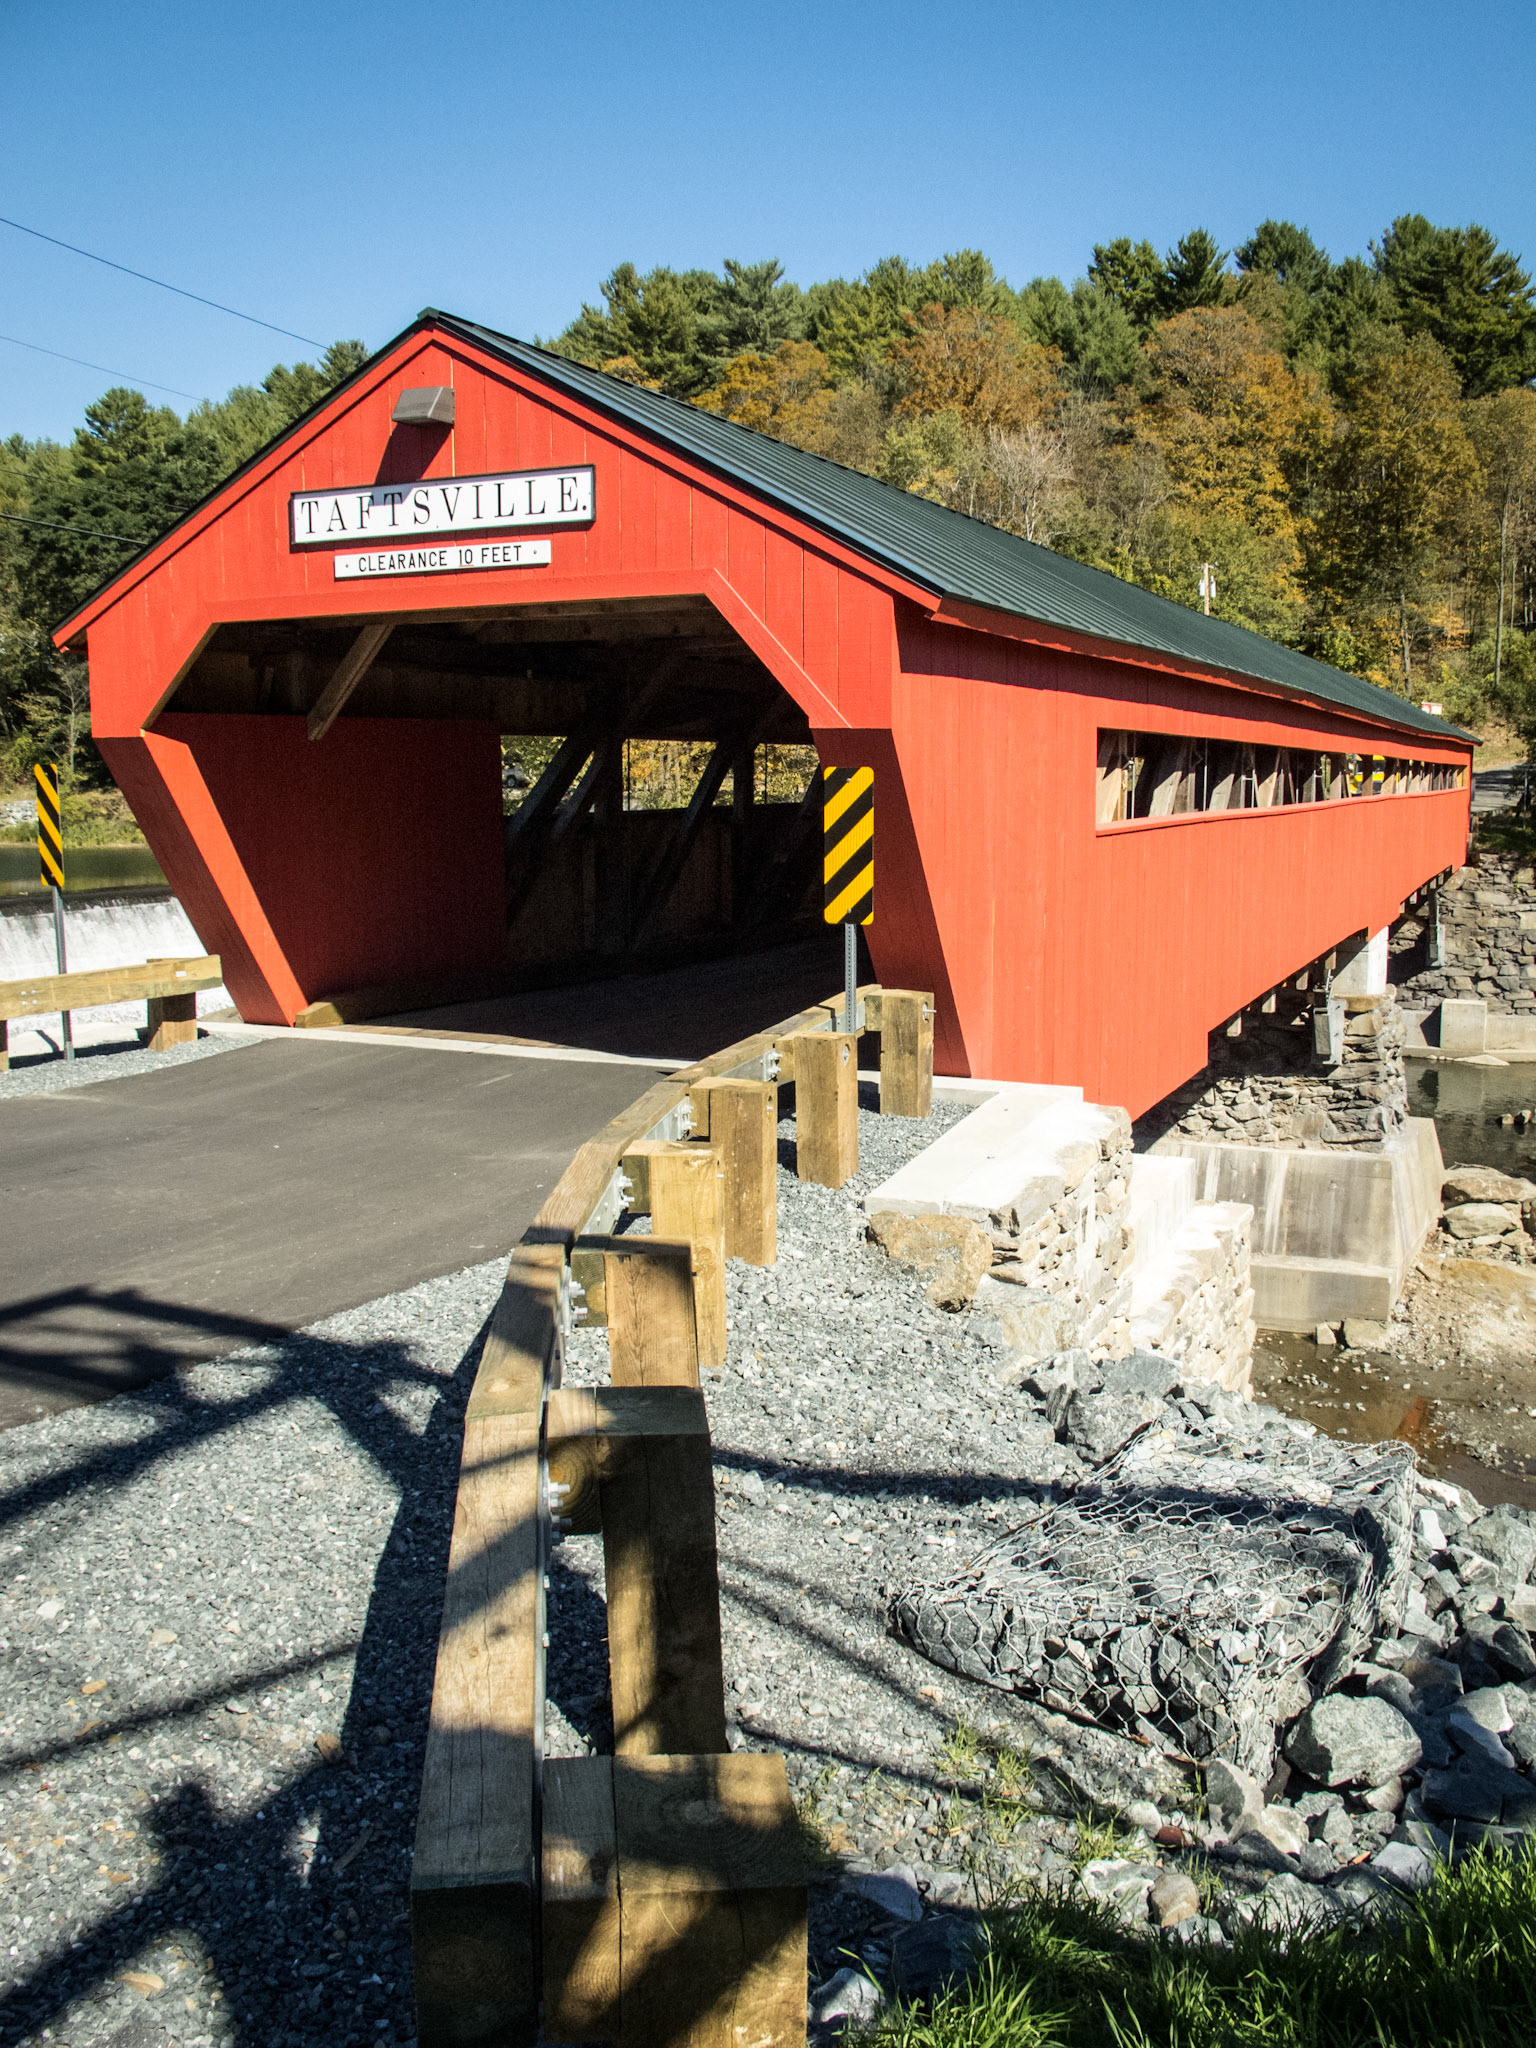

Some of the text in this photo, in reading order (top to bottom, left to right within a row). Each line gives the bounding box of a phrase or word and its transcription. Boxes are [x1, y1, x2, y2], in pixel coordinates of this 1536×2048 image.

[358, 545, 523, 573] CLEARANCE 10 FEET
